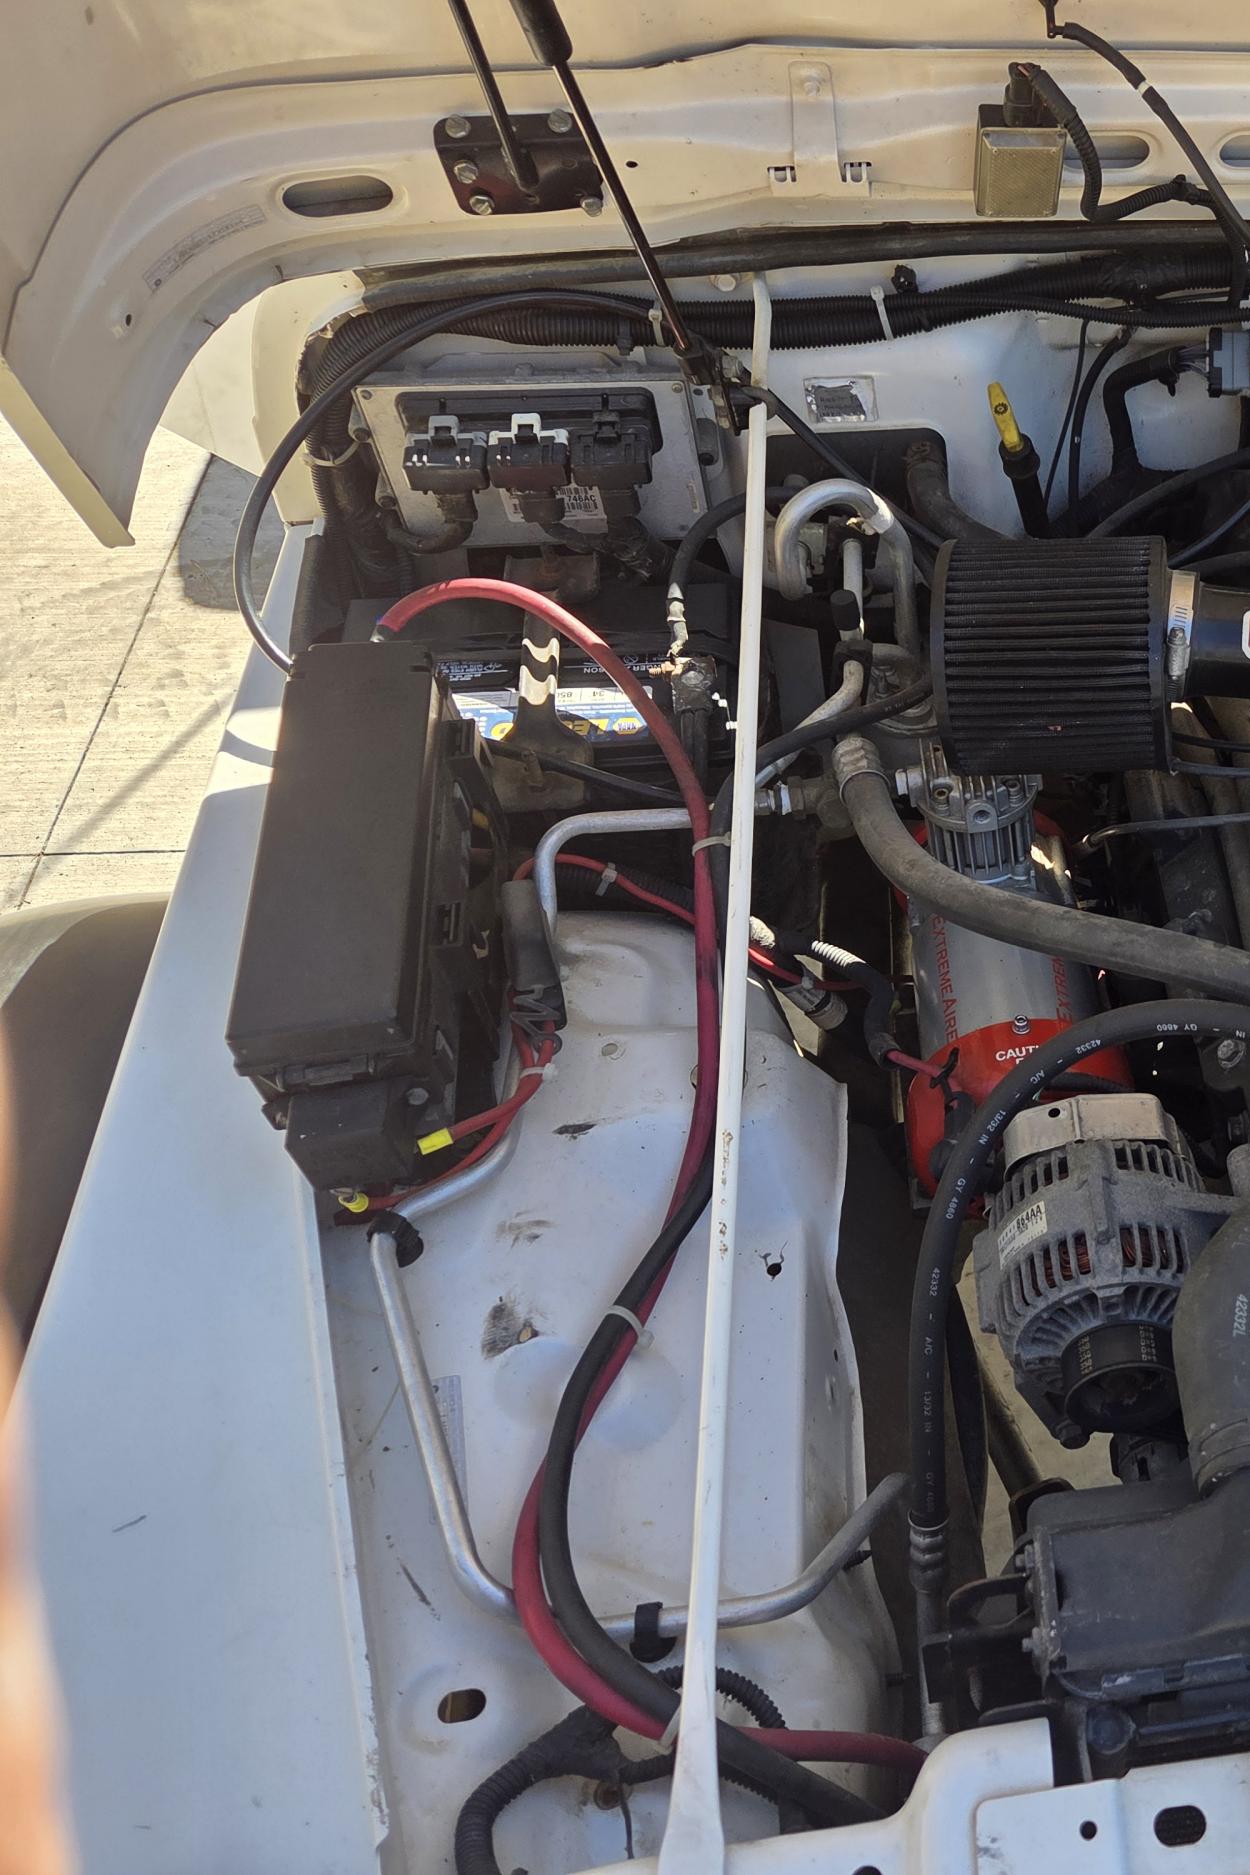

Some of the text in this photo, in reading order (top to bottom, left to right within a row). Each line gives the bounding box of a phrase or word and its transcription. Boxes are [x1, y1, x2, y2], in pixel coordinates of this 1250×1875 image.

[931, 912, 960, 1043] EXTREME AIRE
[1235, 1029, 1246, 1039] IN
[1074, 1038, 1102, 1055] 42332
[986, 1109, 1007, 1133] 13/32
[978, 1133, 990, 1145] IN
[954, 1177, 967, 1194] GY
[928, 1266, 941, 1297] 42332
[1232, 1293, 1249, 1338] 42332L
[923, 1336, 934, 1355] A/C
